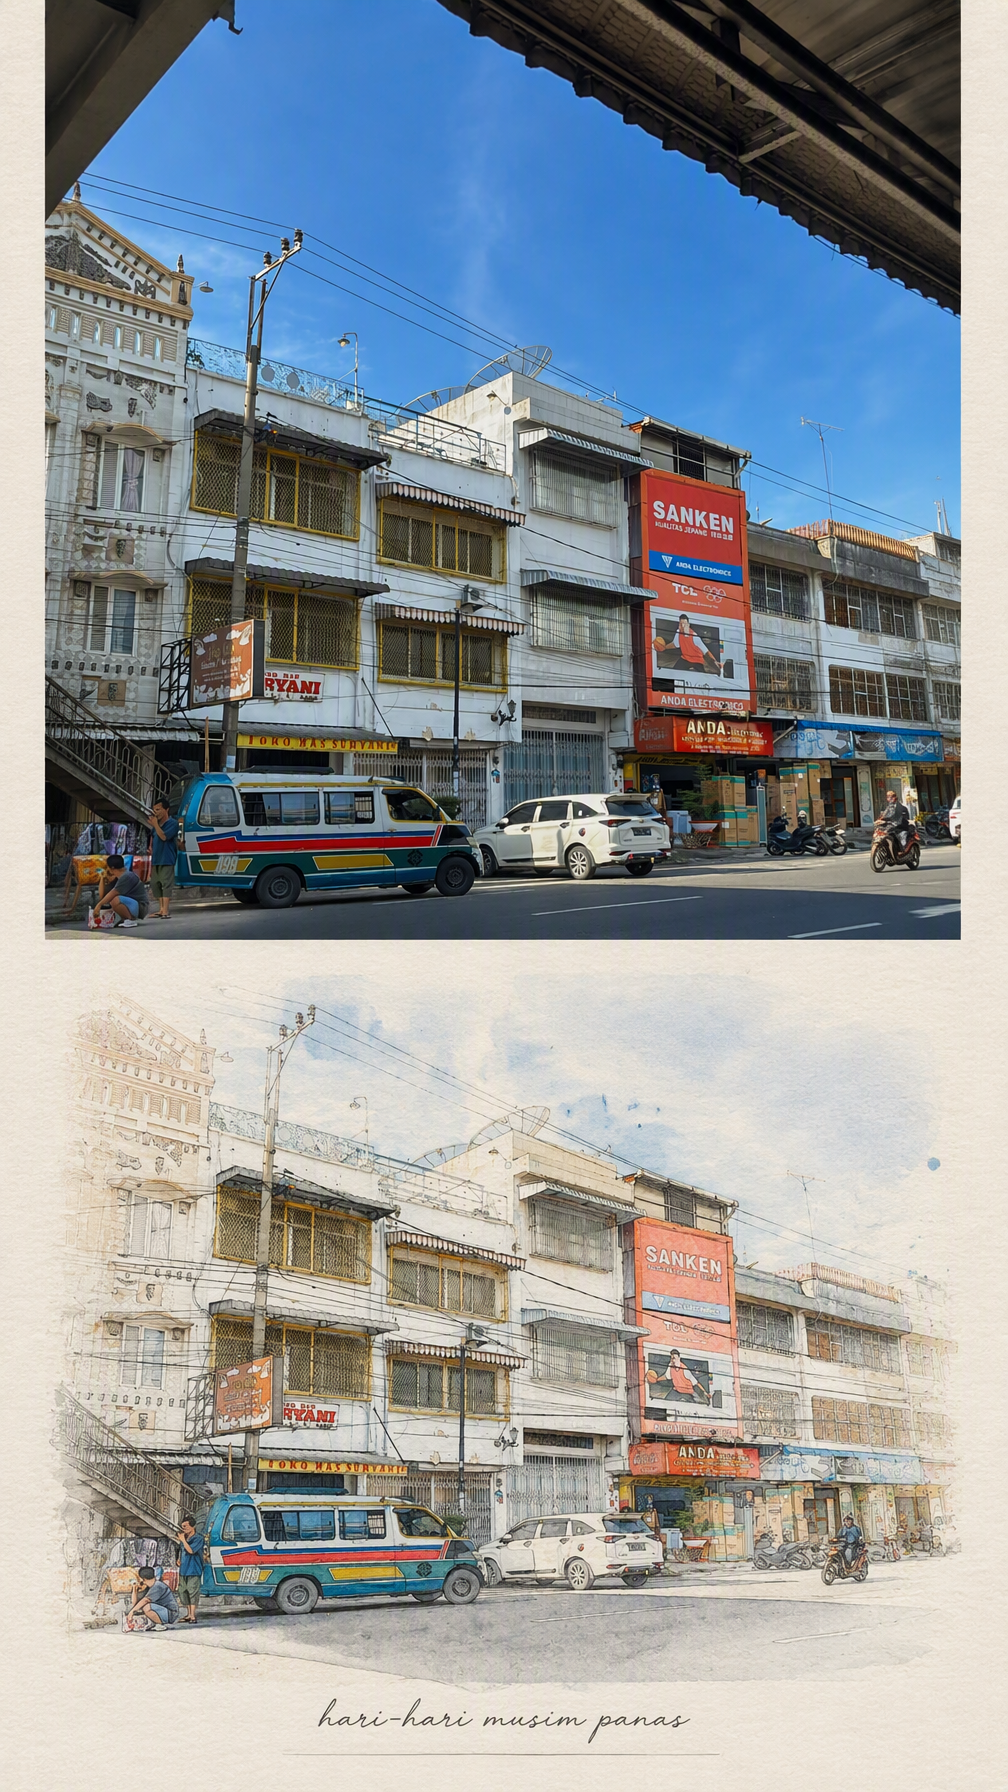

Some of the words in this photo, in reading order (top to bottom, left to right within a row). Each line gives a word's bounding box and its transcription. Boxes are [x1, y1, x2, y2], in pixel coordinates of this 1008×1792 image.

[653, 500, 734, 534] SANKEN
[671, 582, 698, 597] TCL
[660, 695, 687, 707] ANDA
[687, 720, 726, 736] ANDA
[646, 1245, 722, 1275] SANKEN
[679, 1446, 715, 1459] ANDA
